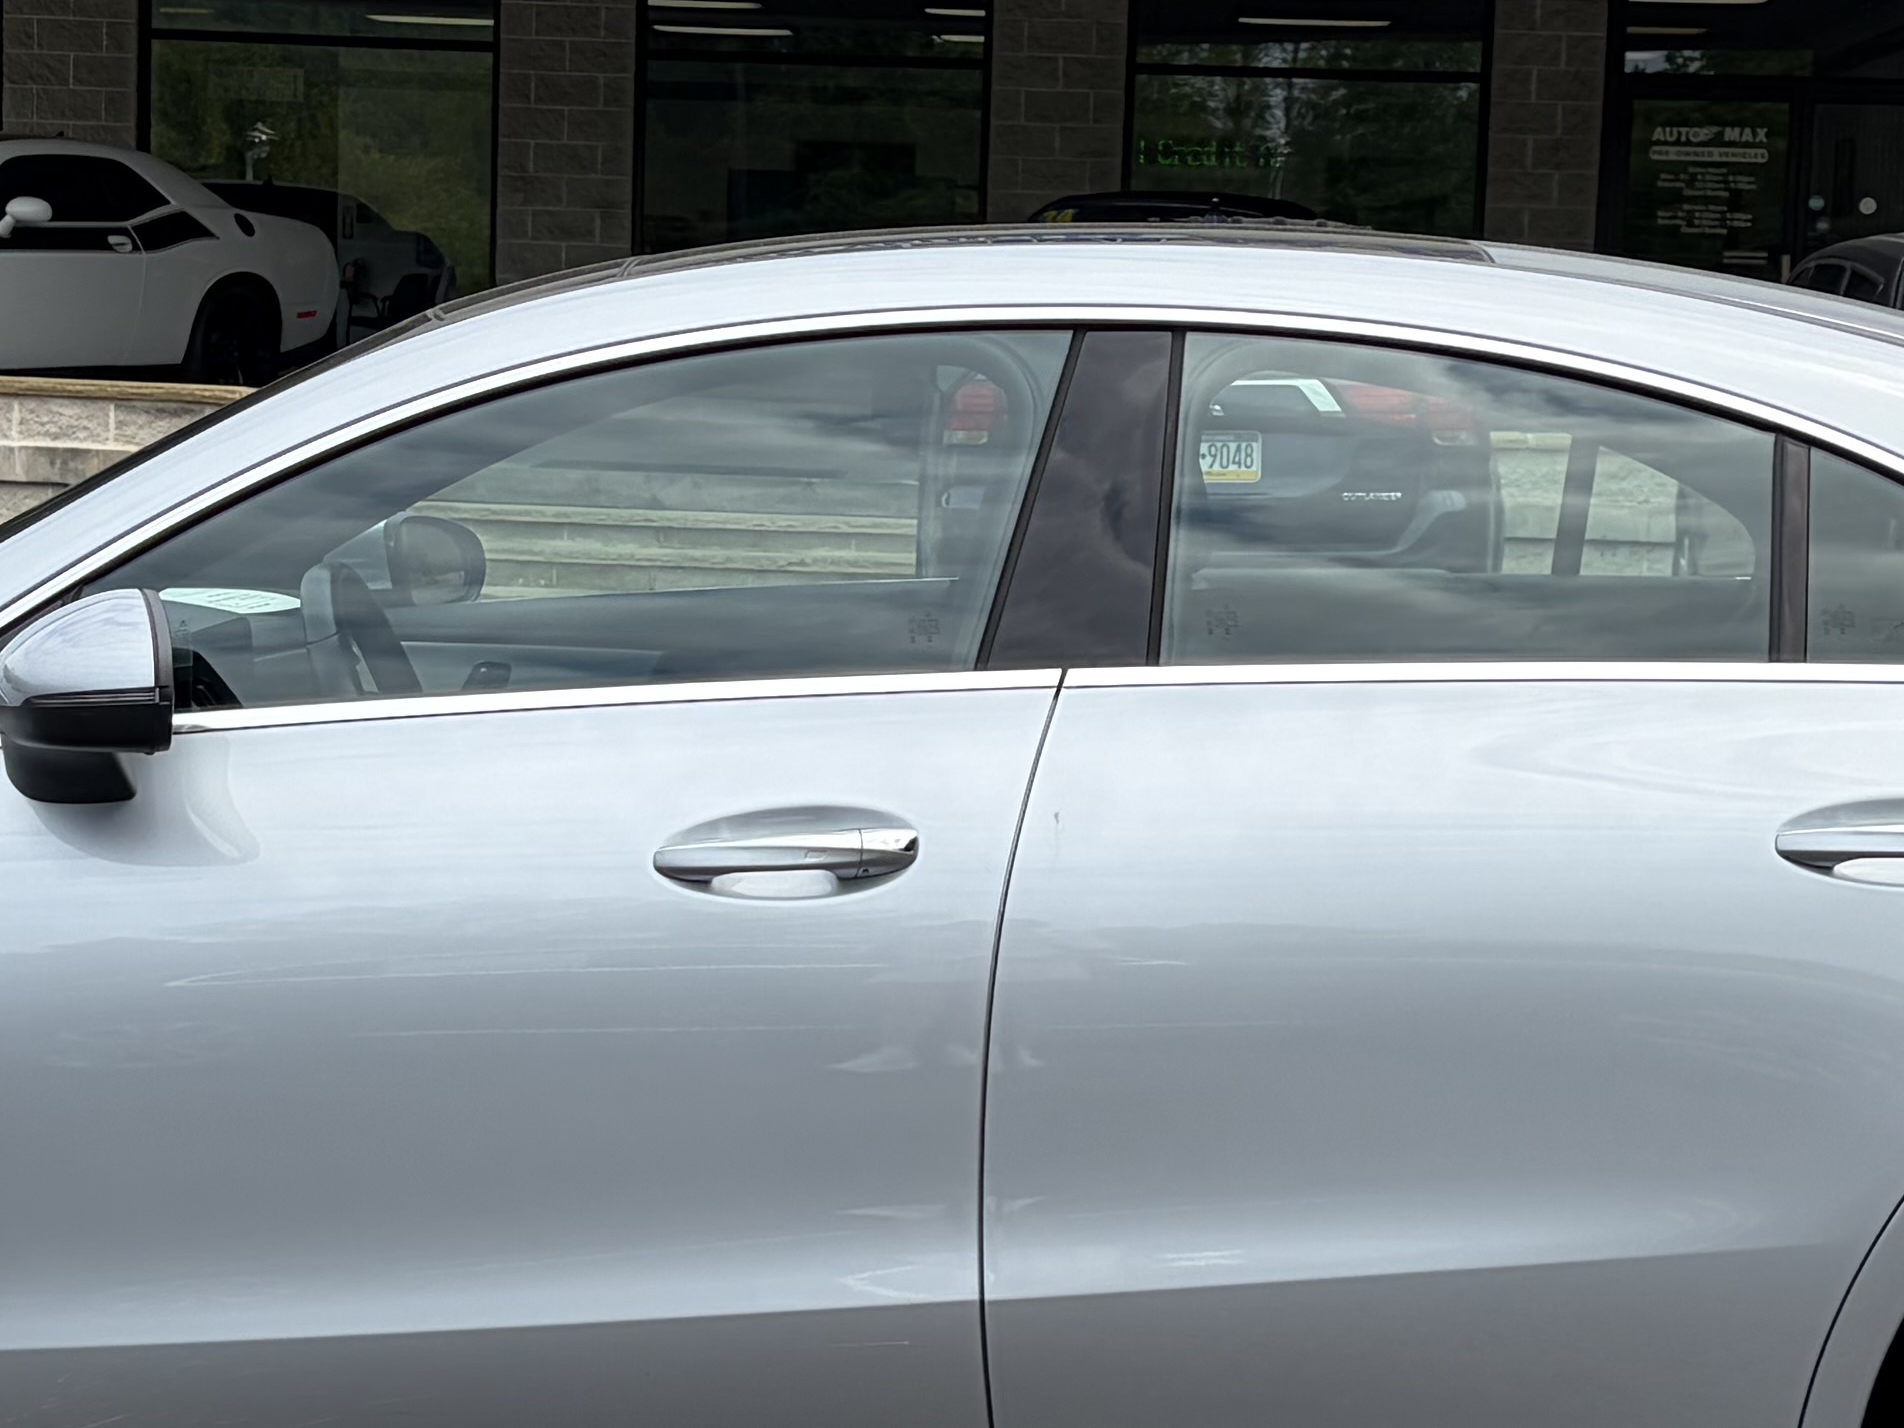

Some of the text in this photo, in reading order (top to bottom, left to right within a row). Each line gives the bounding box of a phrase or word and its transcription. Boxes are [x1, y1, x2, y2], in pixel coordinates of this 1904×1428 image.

[1651, 126, 1768, 143] AUTO MAX
[1207, 443, 1254, 469] 9048
